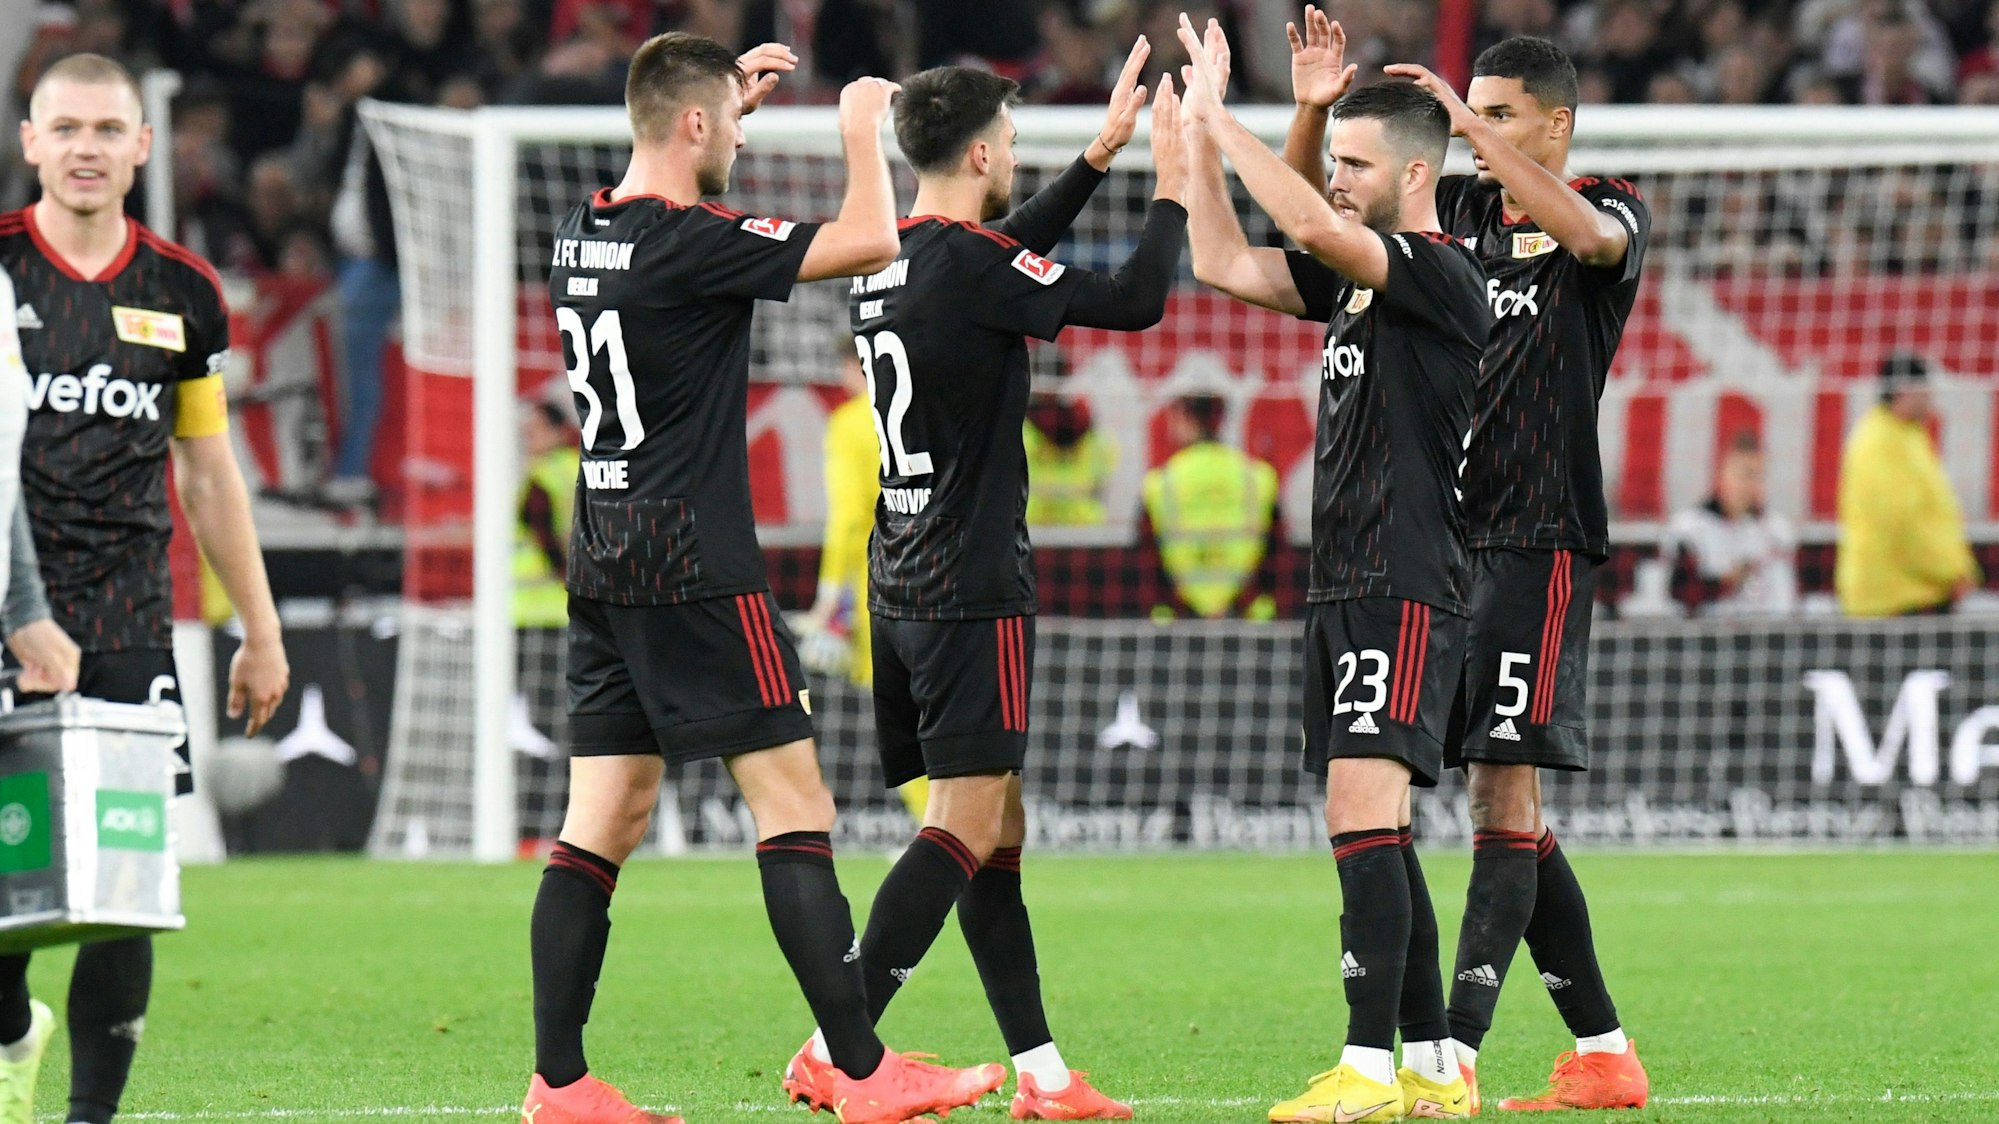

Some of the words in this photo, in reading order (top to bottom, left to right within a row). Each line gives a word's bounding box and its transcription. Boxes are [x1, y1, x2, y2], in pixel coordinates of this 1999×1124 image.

[561, 239, 579, 268] FC
[580, 240, 634, 270] UNION
[556, 306, 645, 451] 31
[1333, 649, 1390, 715] 23
[1495, 652, 1531, 717] 5
[1348, 724, 1380, 735] adidas
[1489, 729, 1521, 741] adidas
[1457, 971, 1499, 988] adidas
